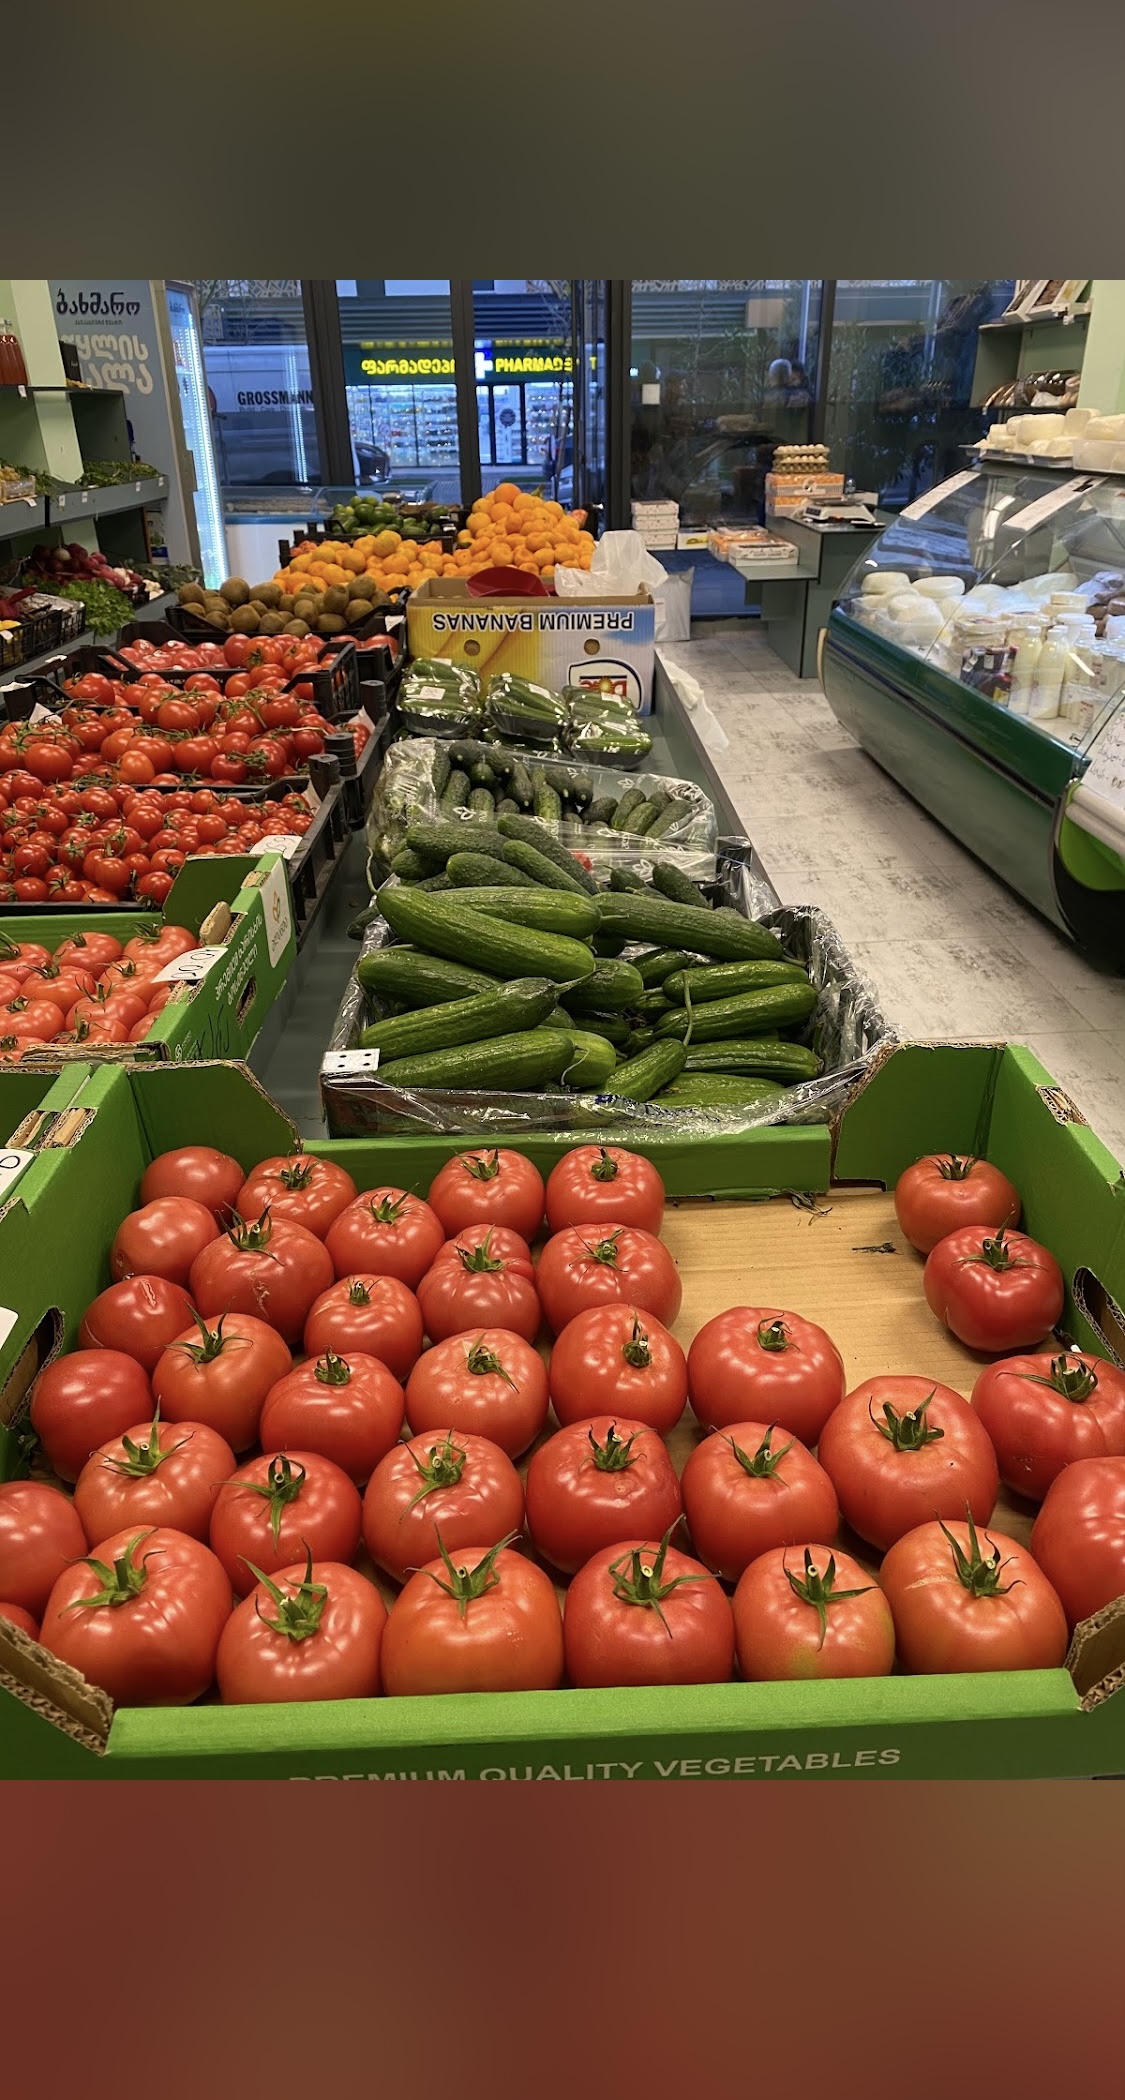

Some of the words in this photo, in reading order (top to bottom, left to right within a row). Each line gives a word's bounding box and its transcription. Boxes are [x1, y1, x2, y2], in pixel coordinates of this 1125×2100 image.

[56, 288, 140, 315] ბახმარო
[79, 363, 154, 395] ალა
[433, 613, 533, 631] BANANAS
[540, 612, 634, 630] PREMIUM
[479, 1762, 643, 1780] QUALITY
[653, 1749, 901, 1777] VEGETABLES
